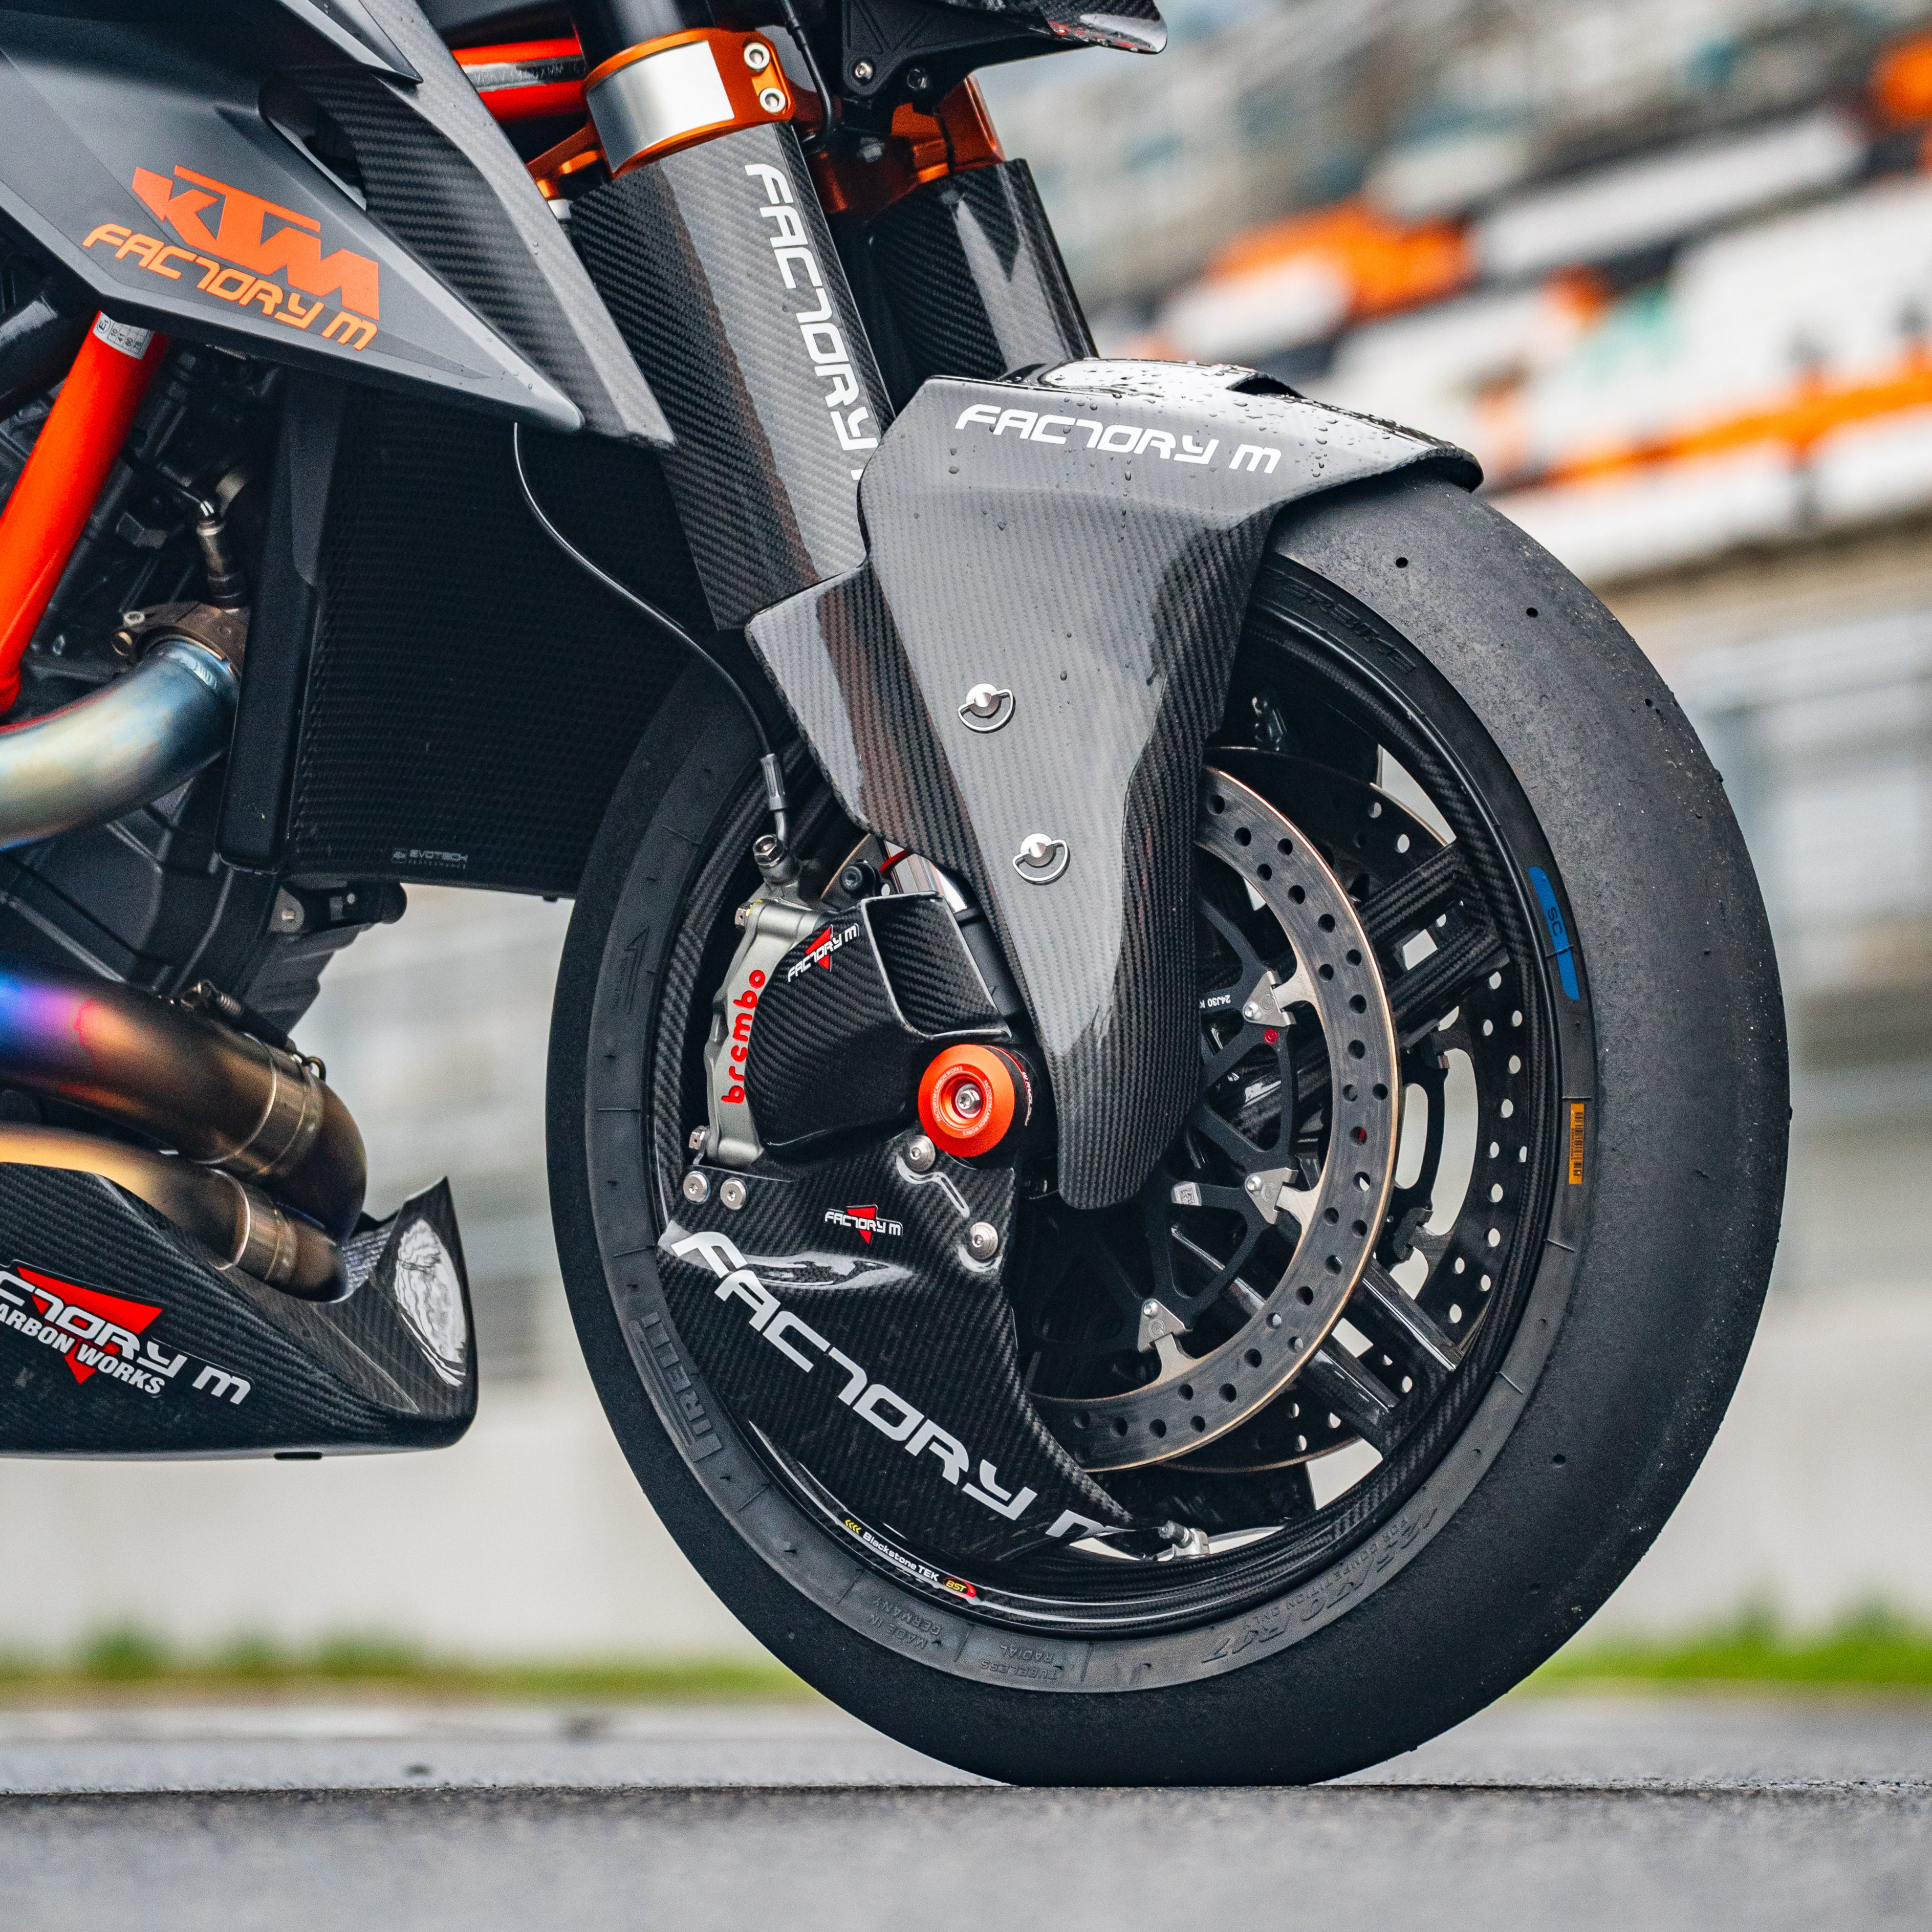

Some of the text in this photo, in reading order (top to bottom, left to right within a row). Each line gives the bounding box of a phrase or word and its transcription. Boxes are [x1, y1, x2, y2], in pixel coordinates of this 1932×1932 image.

[132, 165, 379, 320] KTM
[82, 224, 324, 329] FACTORY
[745, 164, 878, 450] FACTORY
[955, 404, 1220, 465] FACTORY
[1547, 906, 1562, 937] SC
[787, 934, 843, 983] FACTORY
[721, 969, 766, 1104] brembo
[825, 1211, 886, 1233] FACTORY
[76, 1343, 165, 1395] WORKS
[671, 1231, 1037, 1521] FACTORY
[862, 1531, 967, 1592] Blackstone TEK BST
[873, 1597, 941, 1636] GERMANY
[980, 1660, 1058, 1681] TUBELESS
[1000, 1644, 1055, 1663] RADIAL
